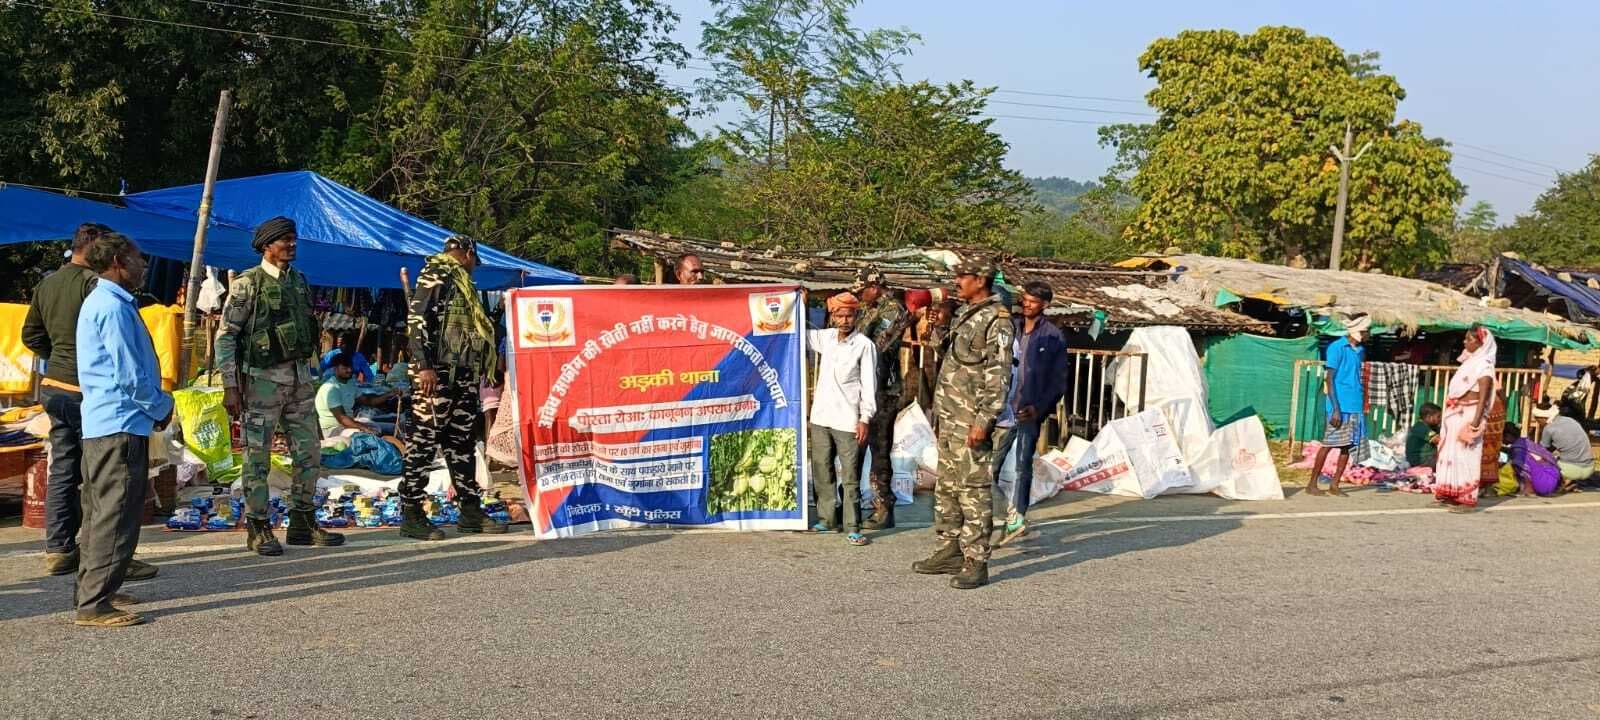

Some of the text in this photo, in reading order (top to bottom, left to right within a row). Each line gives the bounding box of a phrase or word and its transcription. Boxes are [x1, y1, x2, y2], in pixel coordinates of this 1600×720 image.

[552, 354, 587, 397] अफीम
[583, 339, 601, 360] की
[599, 323, 629, 349] खेती
[629, 315, 654, 335] नहीं
[656, 314, 688, 331] करने
[689, 315, 708, 340] हेतु
[757, 359, 788, 410] अभियान
[619, 369, 721, 392] अड़की थाना
[577, 411, 611, 427] पोस्ता
[649, 407, 692, 421] कानूनन
[697, 403, 732, 416] अपराध
[620, 447, 628, 456] 10
[644, 508, 682, 520] पुलिस
